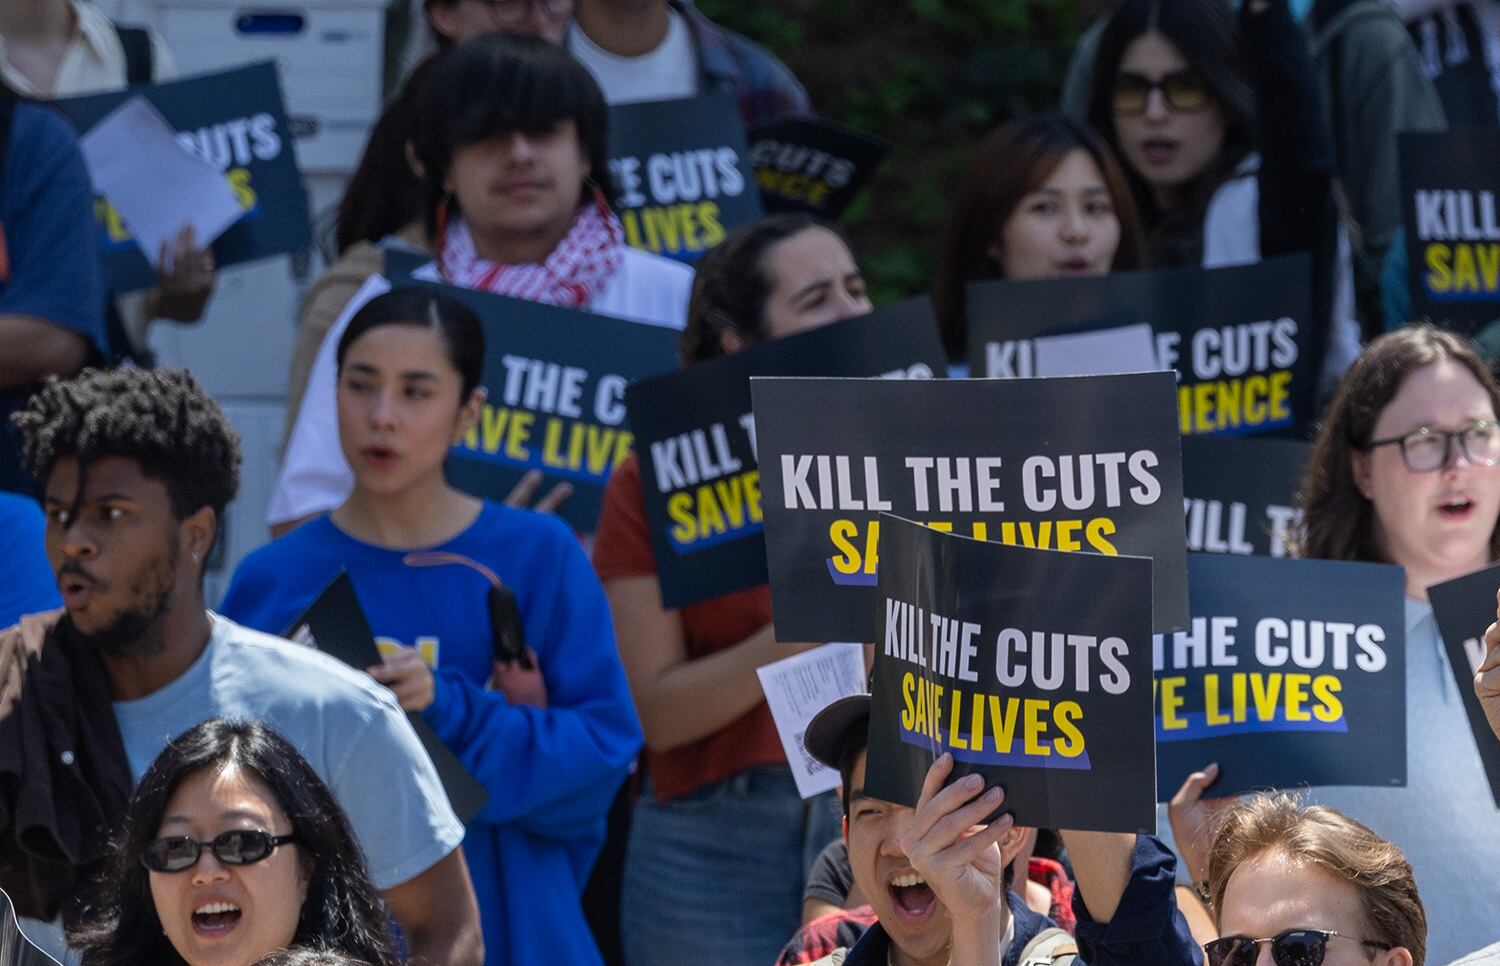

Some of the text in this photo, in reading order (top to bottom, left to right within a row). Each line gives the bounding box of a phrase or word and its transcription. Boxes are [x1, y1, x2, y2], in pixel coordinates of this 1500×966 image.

[646, 147, 745, 204] CUTS
[1191, 316, 1299, 380] CUTS
[502, 353, 588, 419] THE
[650, 421, 743, 493] KILL
[780, 449, 1162, 513] KILL THE CUTS
[884, 597, 927, 668] KILL
[930, 612, 982, 683] THE
[994, 626, 1132, 696] CUTS
[1254, 616, 1388, 673] CUTS
[901, 671, 943, 744] SAVE
[948, 689, 1086, 759] LIVES
[1203, 672, 1344, 723] LIVES
